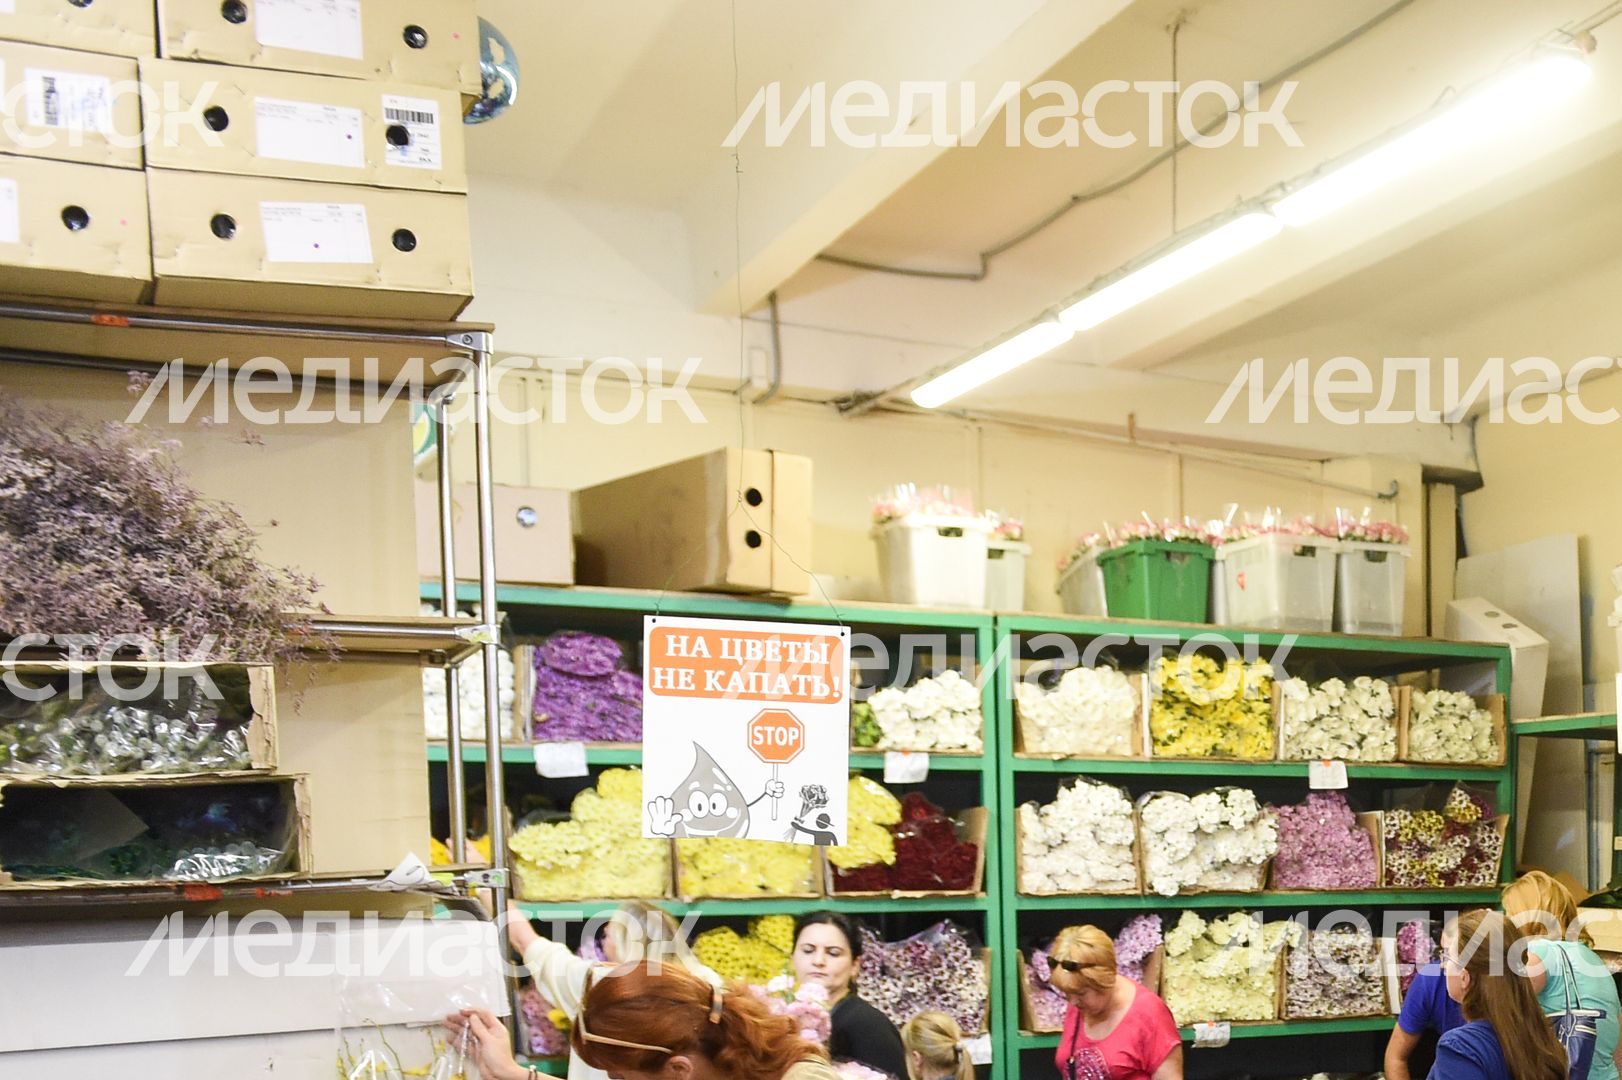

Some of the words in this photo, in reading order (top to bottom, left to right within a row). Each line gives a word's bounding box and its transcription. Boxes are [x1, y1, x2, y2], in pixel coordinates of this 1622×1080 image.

[665, 634, 712, 659] НА
[719, 637, 830, 666] ЦВЕТЫ
[652, 667, 696, 691] НЕ
[703, 669, 841, 698] КАПАТЬ!
[753, 725, 800, 747] STOP
